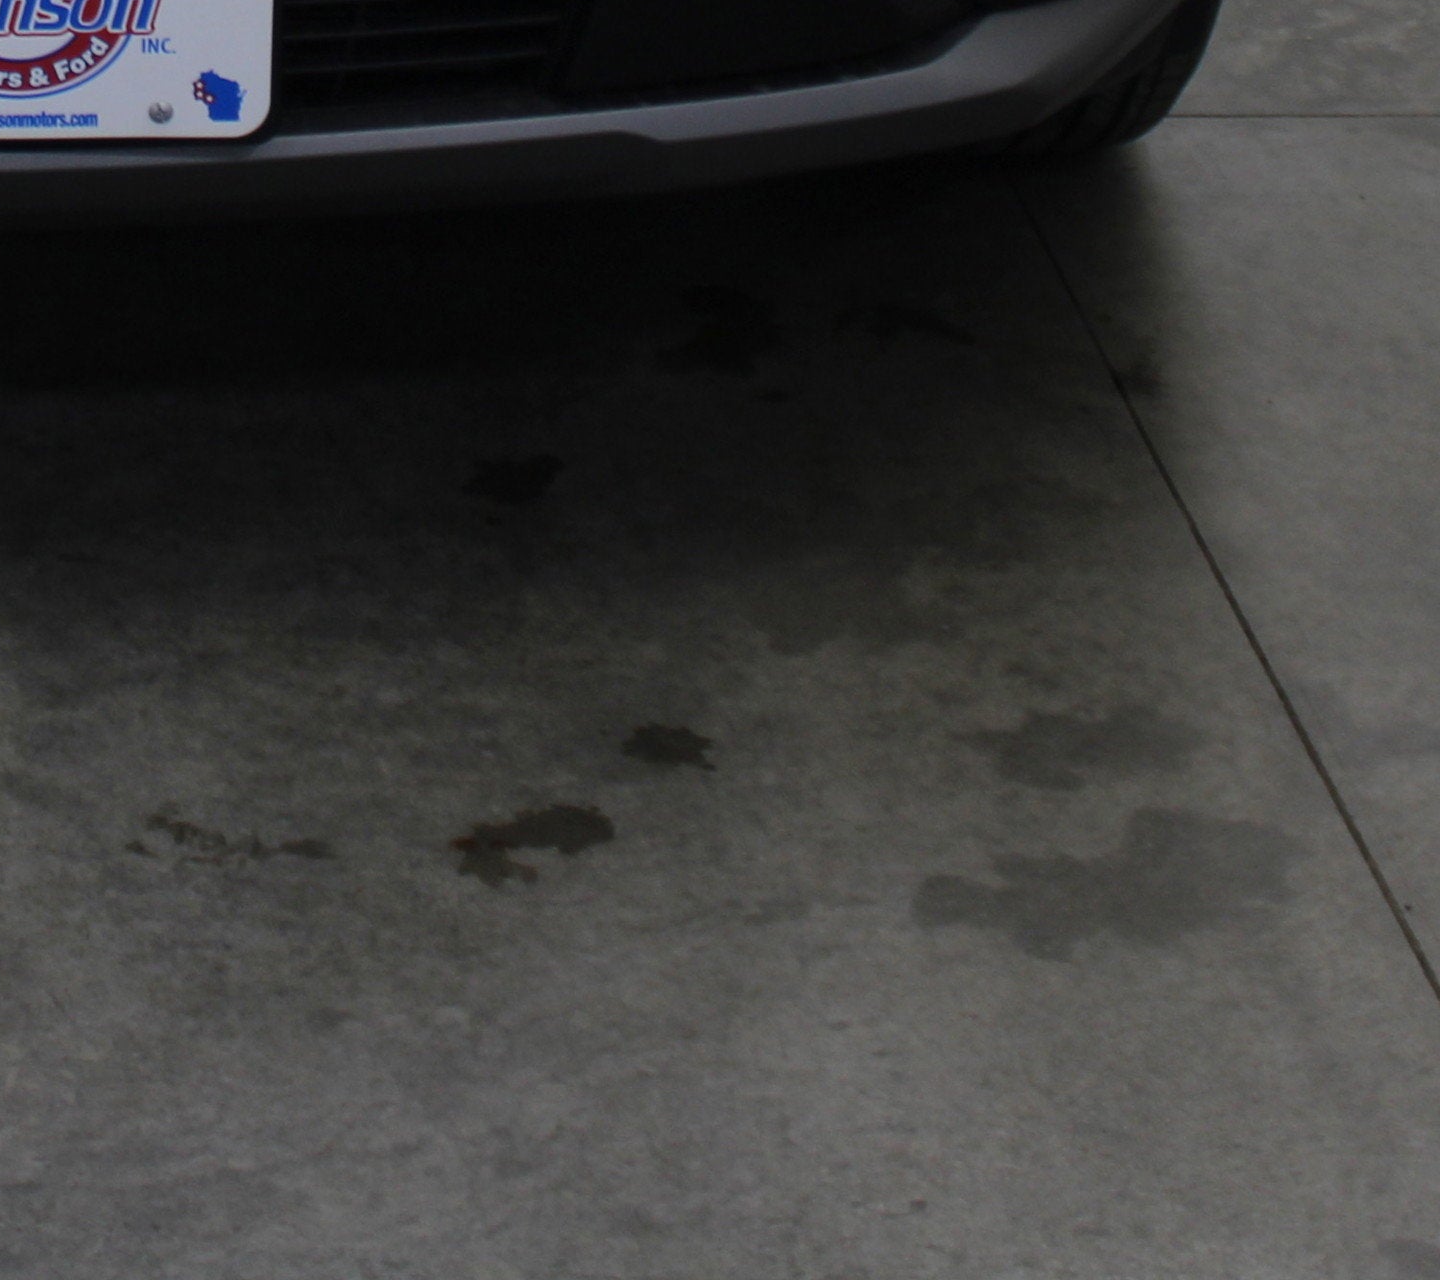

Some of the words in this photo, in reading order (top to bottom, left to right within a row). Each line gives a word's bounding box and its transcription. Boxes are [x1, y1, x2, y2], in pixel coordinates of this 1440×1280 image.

[29, 67, 50, 88] &
[53, 36, 109, 81] Ford
[141, 37, 176, 54] INC.
